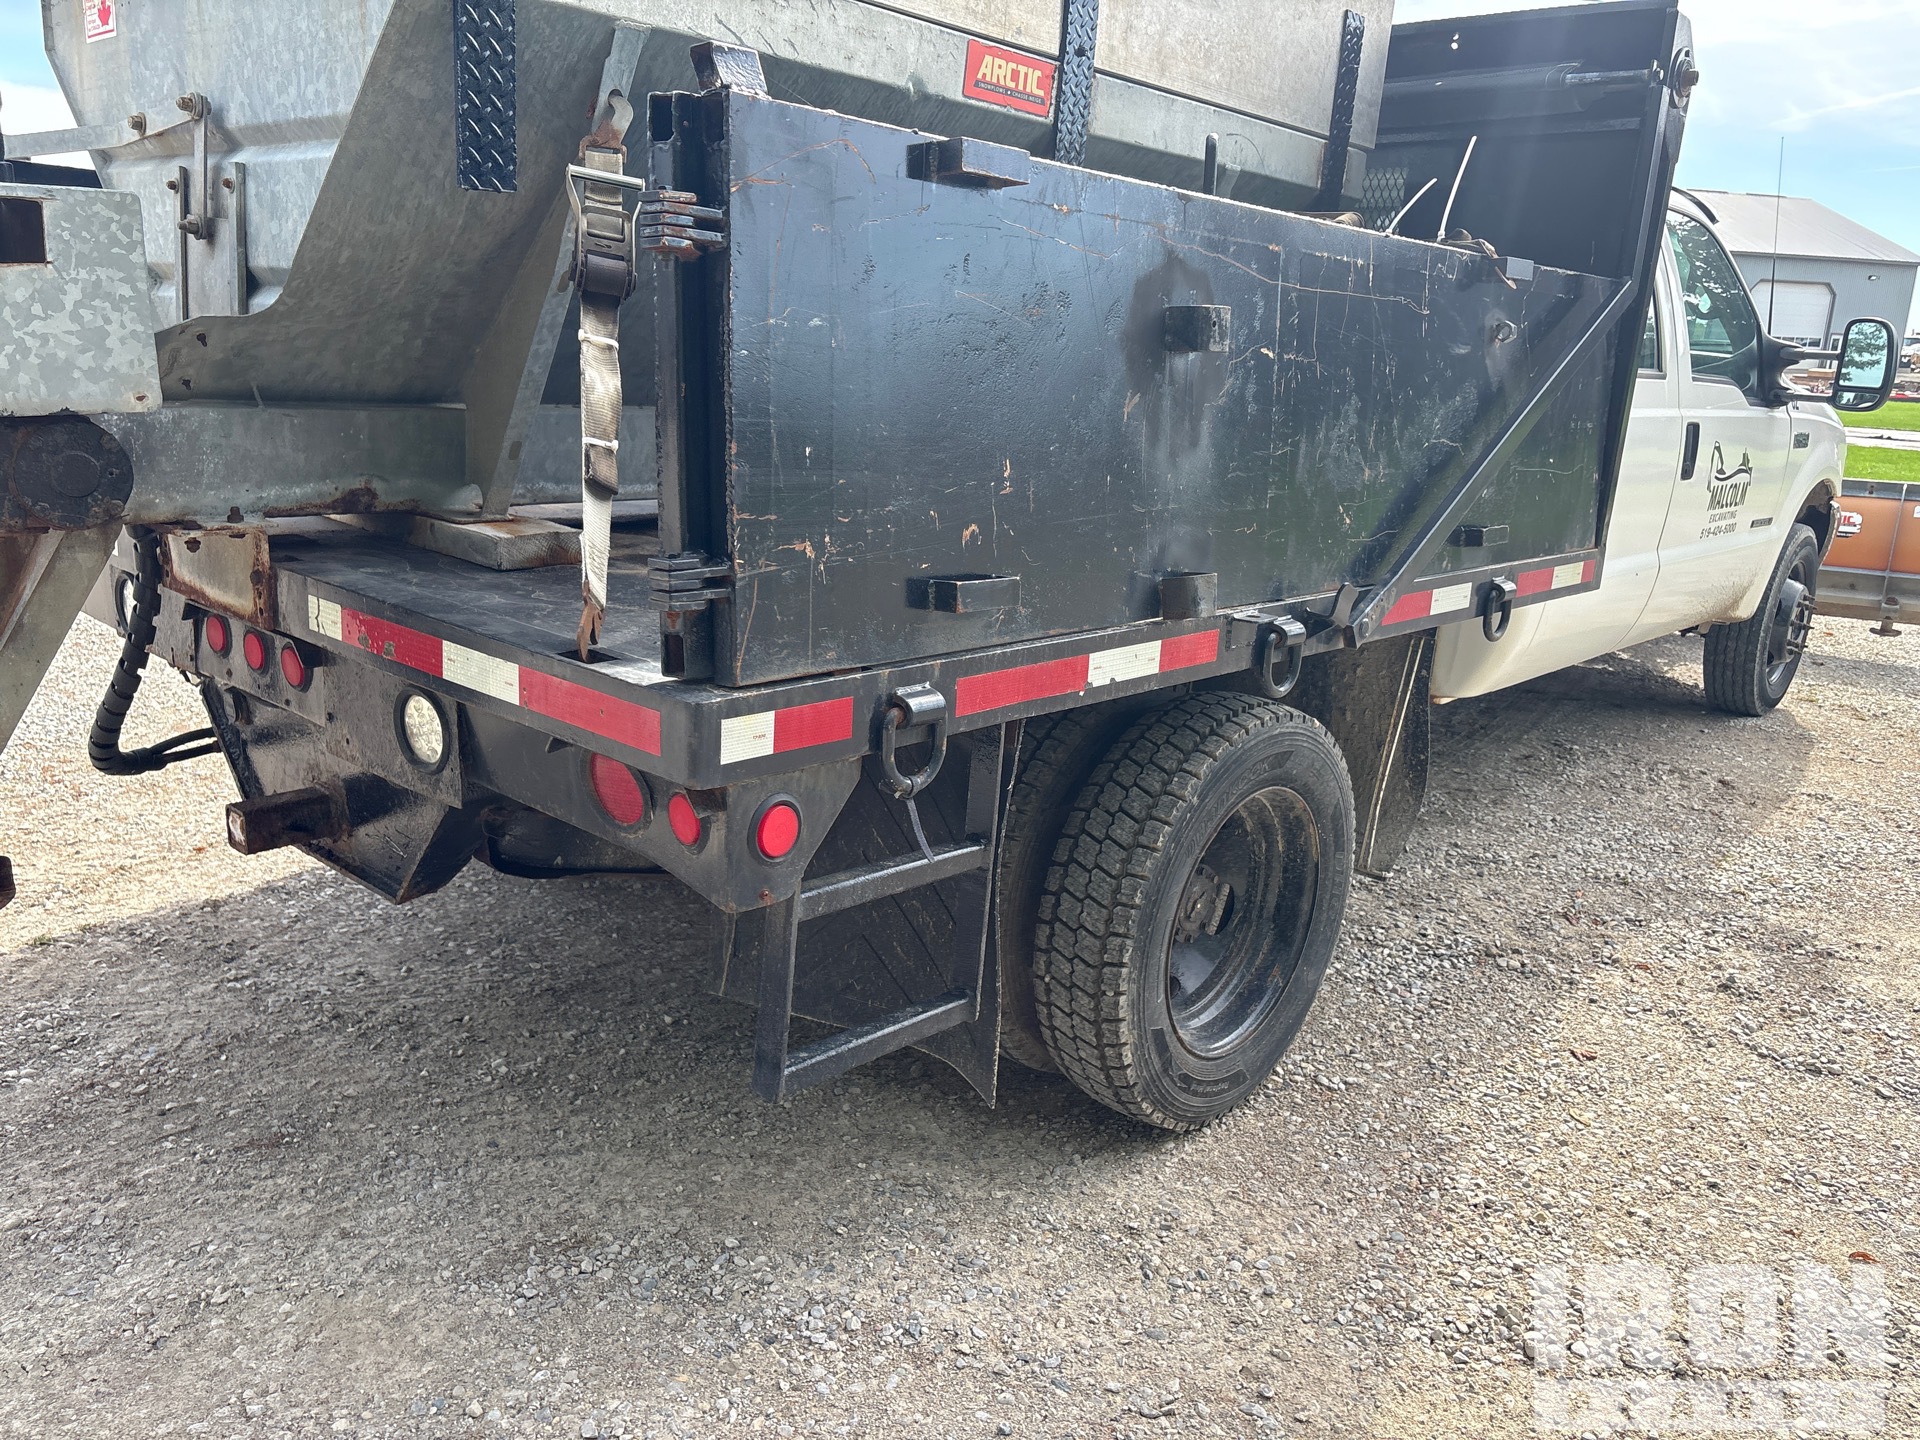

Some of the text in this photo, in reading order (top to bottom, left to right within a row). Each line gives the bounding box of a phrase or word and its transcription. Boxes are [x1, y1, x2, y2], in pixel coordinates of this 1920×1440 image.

[976, 54, 1044, 97] ARCTIC
[978, 82, 1006, 94] SNOWPLOWS
[1707, 481, 1749, 511] MALCOLM
[1708, 510, 1738, 523] EXCAVATING
[1699, 522, 1737, 540] 519-424-5000
